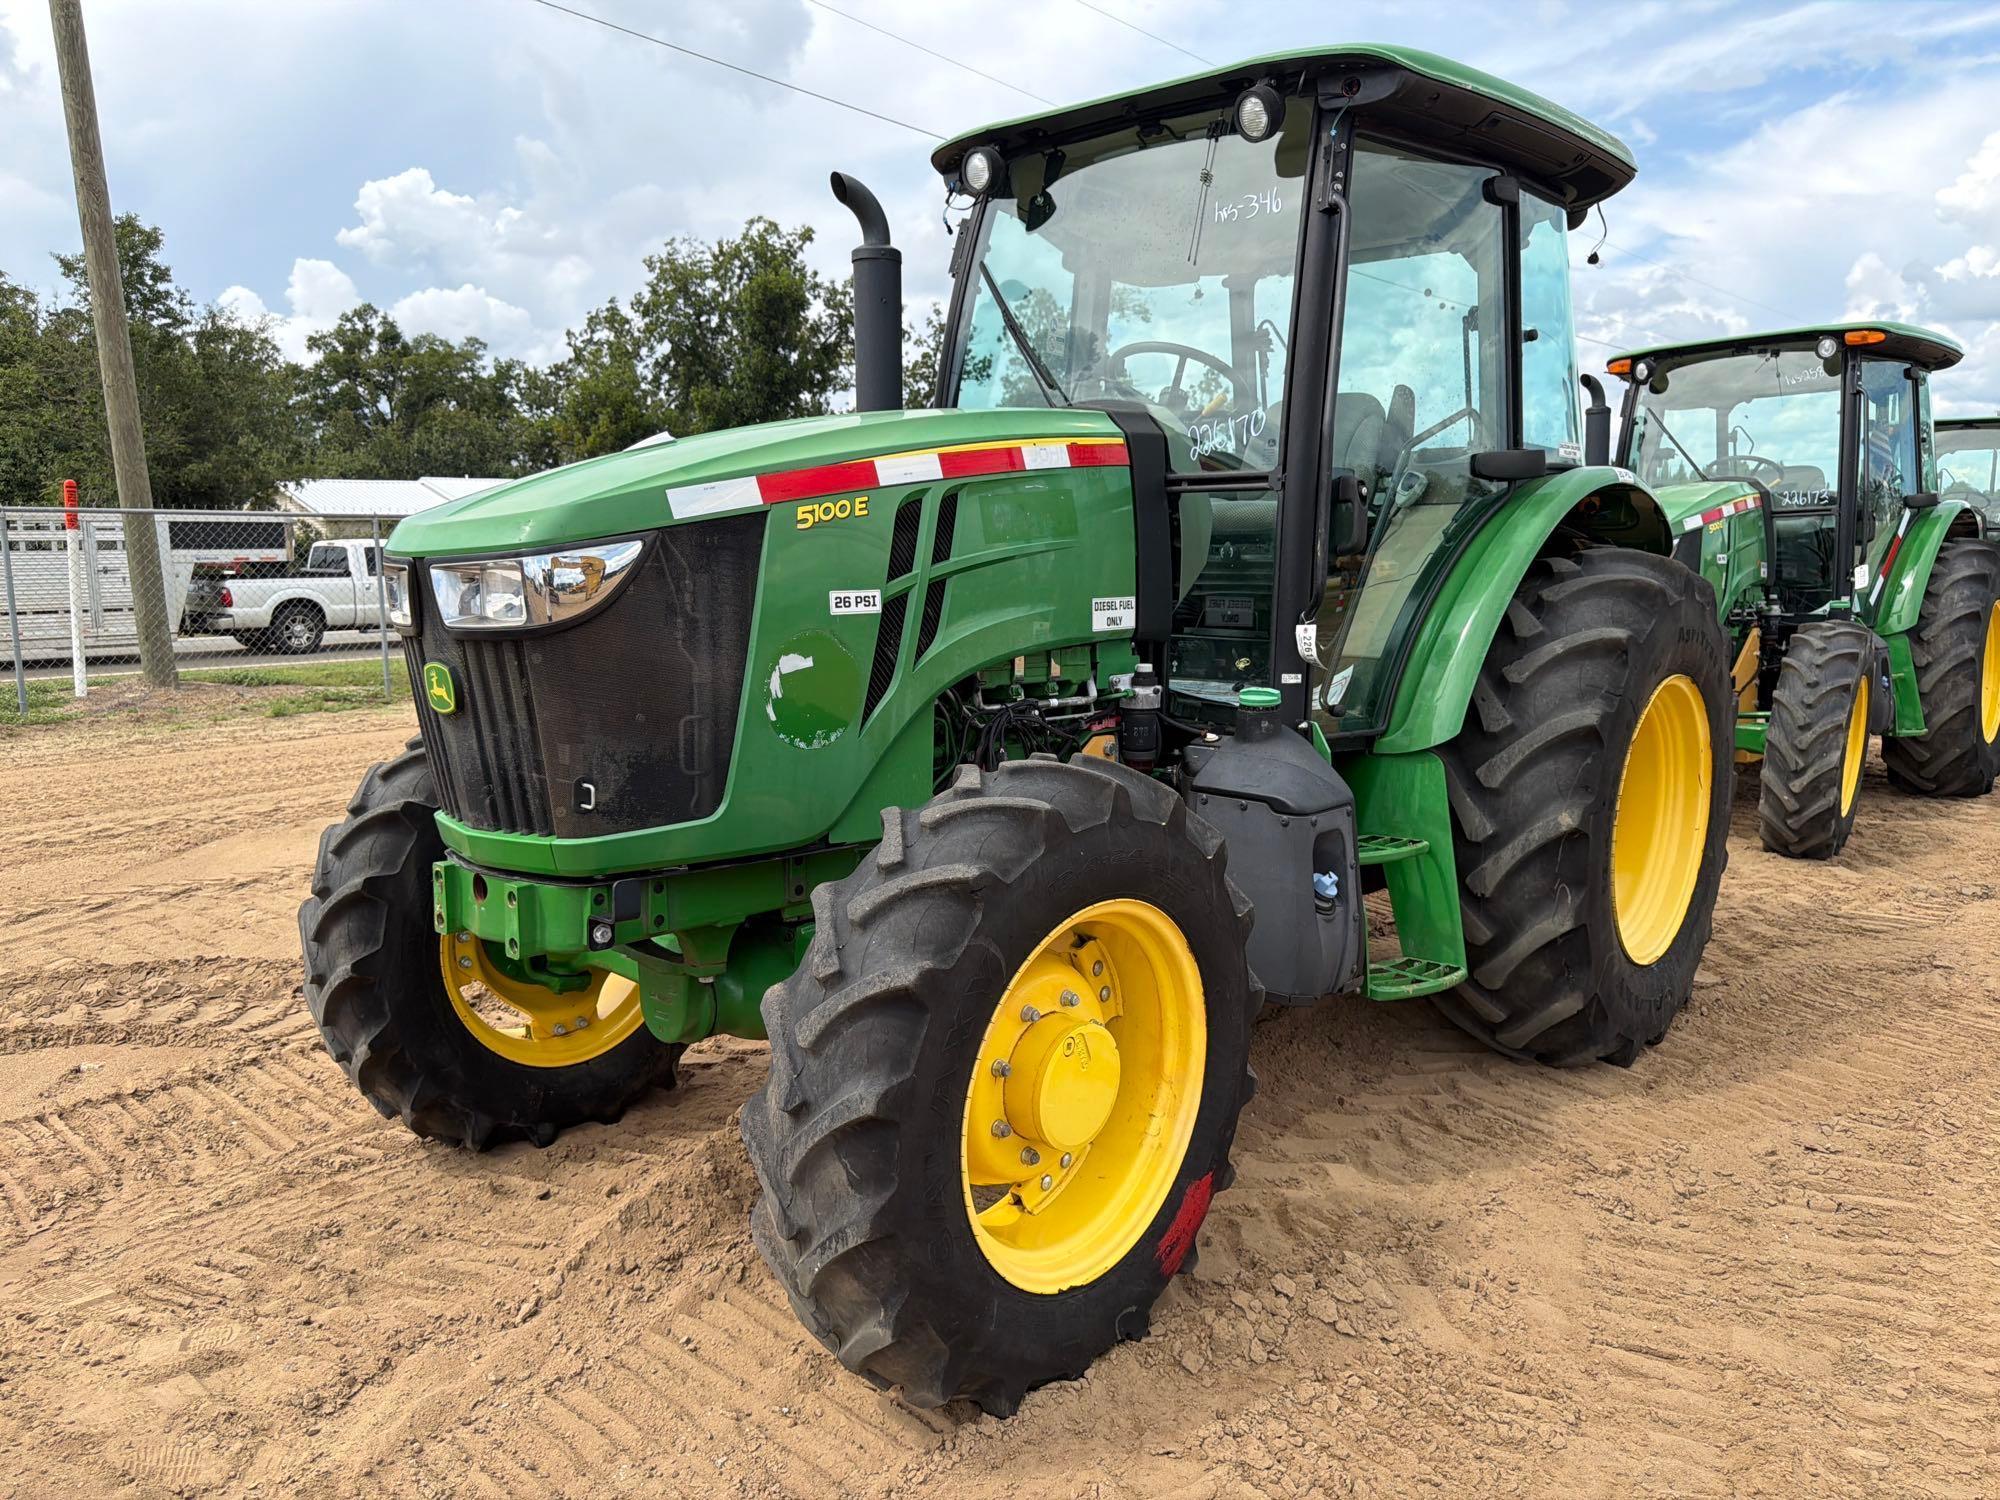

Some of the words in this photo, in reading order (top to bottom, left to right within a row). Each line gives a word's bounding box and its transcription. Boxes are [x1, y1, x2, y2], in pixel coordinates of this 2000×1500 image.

[1187, 408, 1267, 461] 226170
[834, 596, 852, 608] 26
[855, 595, 877, 608] PSI
[1094, 601, 1118, 611] DIESEL
[1119, 600, 1134, 610] FUEL
[1106, 616, 1123, 627] ONLY
